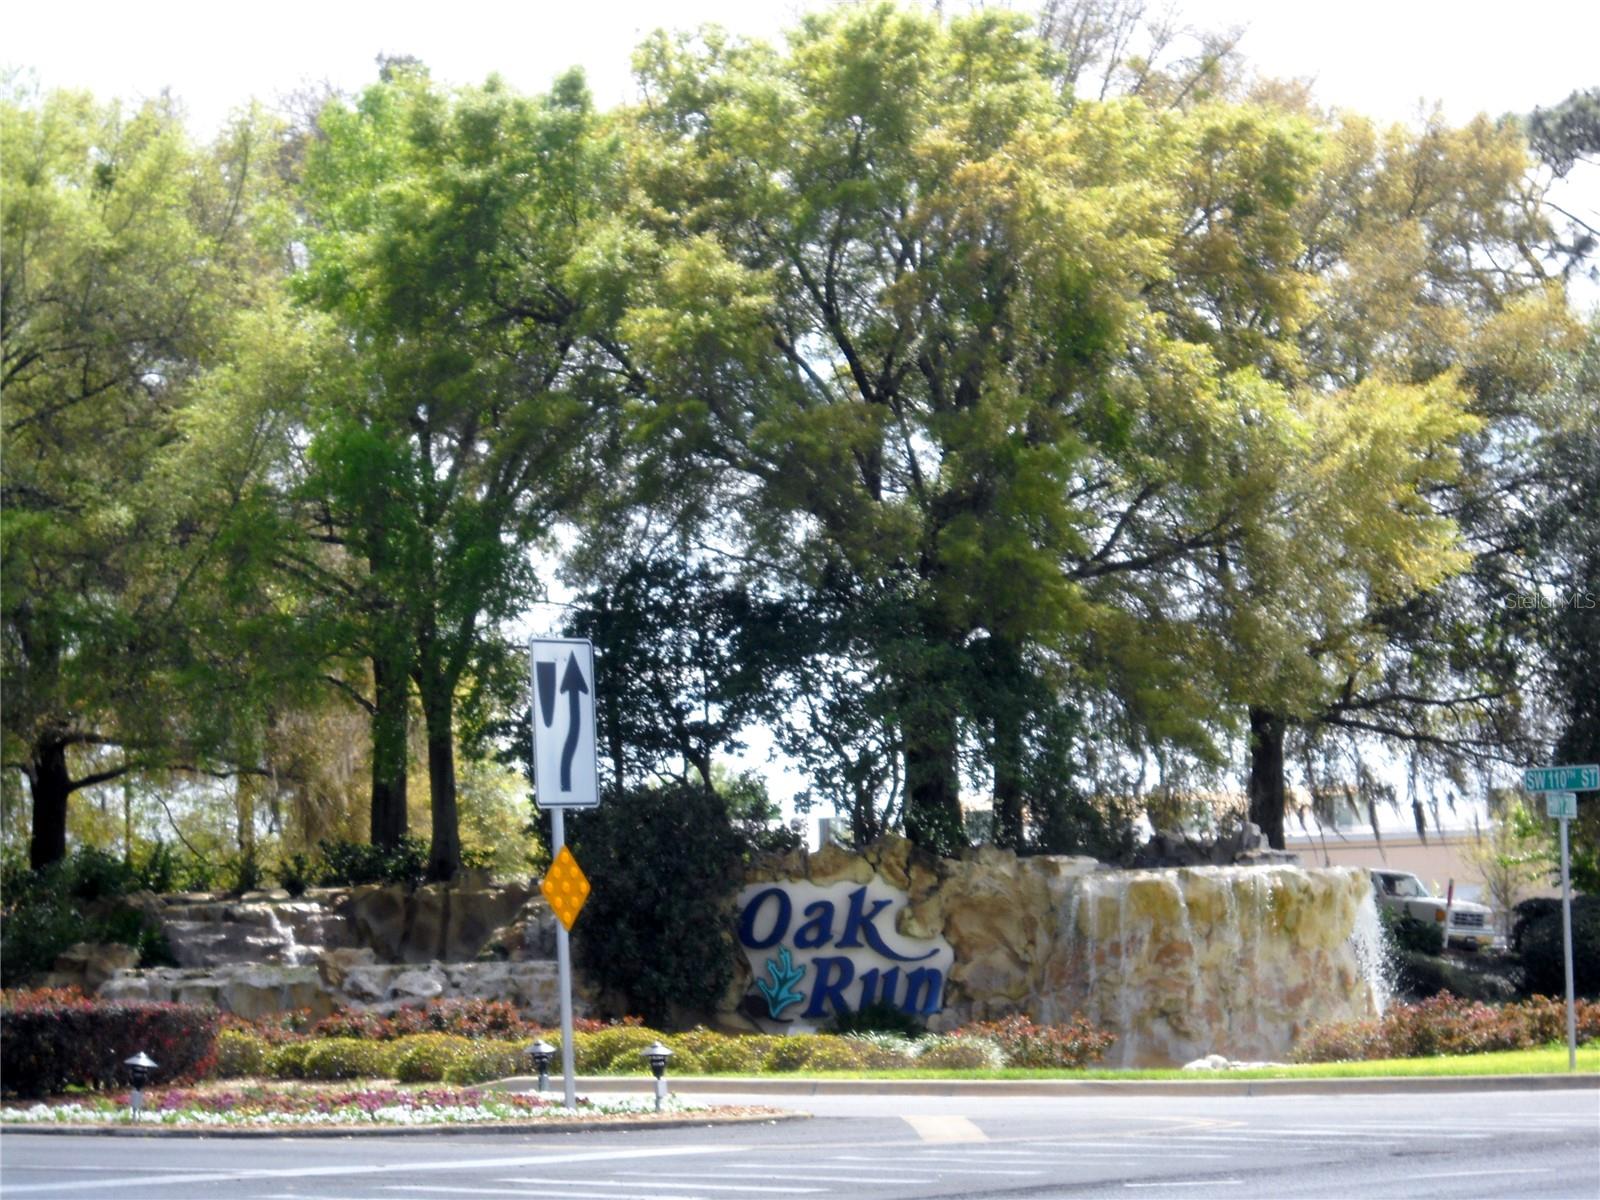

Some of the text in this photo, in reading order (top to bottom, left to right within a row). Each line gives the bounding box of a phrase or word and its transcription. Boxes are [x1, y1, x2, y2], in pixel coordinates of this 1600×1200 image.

[1527, 771, 1545, 790] SW
[1581, 768, 1597, 787] ST
[738, 886, 940, 961] Oak
[801, 956, 943, 1018] Run
